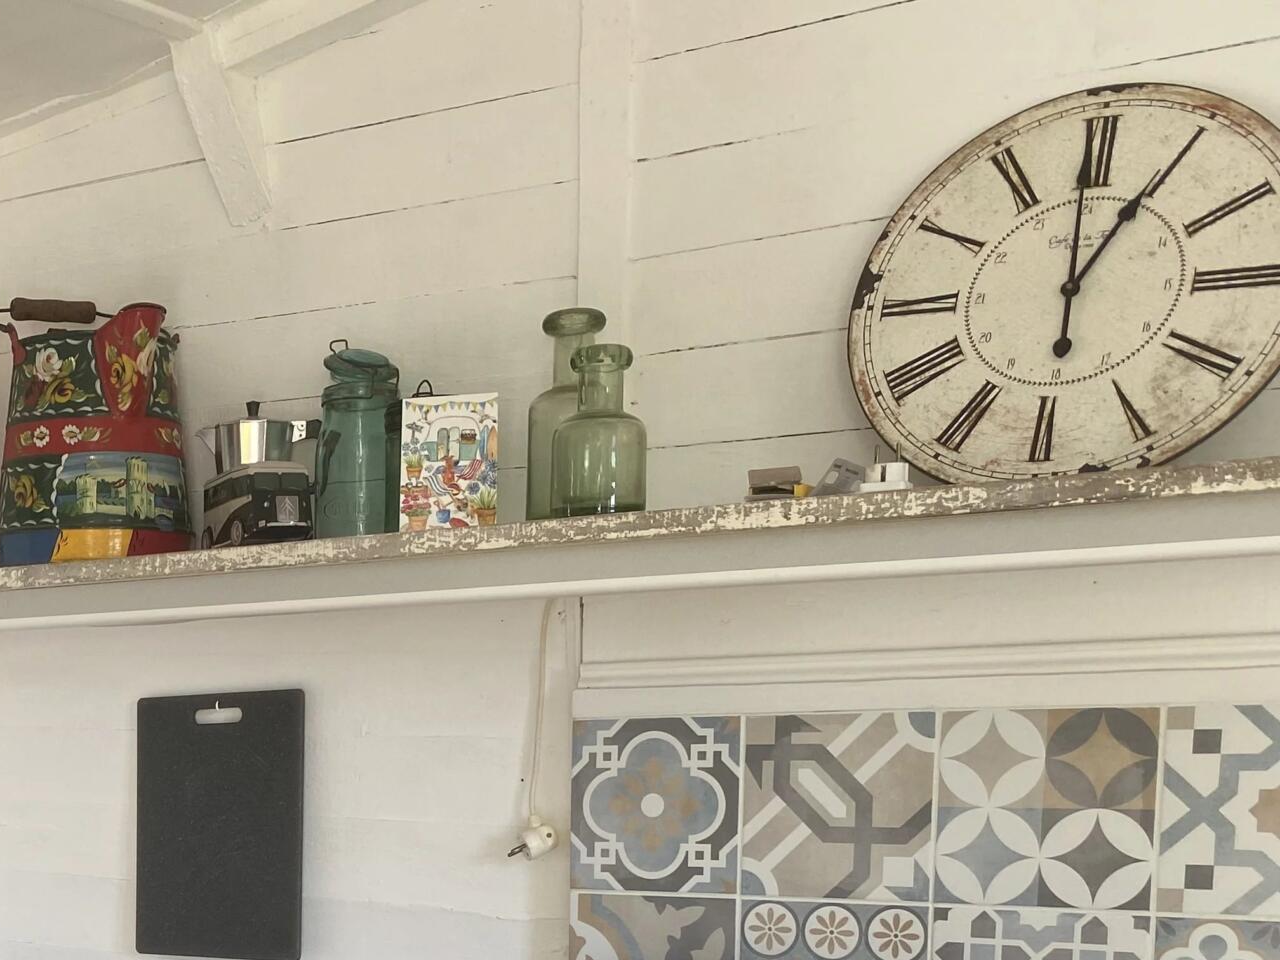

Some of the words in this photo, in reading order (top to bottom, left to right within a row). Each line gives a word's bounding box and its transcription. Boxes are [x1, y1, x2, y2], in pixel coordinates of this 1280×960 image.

[985, 145, 1042, 217] XI
[1182, 177, 1277, 238] II
[916, 216, 989, 258] X
[994, 252, 1007, 264] 22
[880, 290, 960, 321] IX
[975, 293, 985, 304] 21
[1190, 264, 1280, 296] III
[978, 332, 992, 343] 20
[1161, 329, 1246, 382] IV
[882, 335, 967, 407] VIII
[933, 378, 1004, 454] VII
[1024, 395, 1058, 462] VI
[1111, 378, 1158, 444] V
